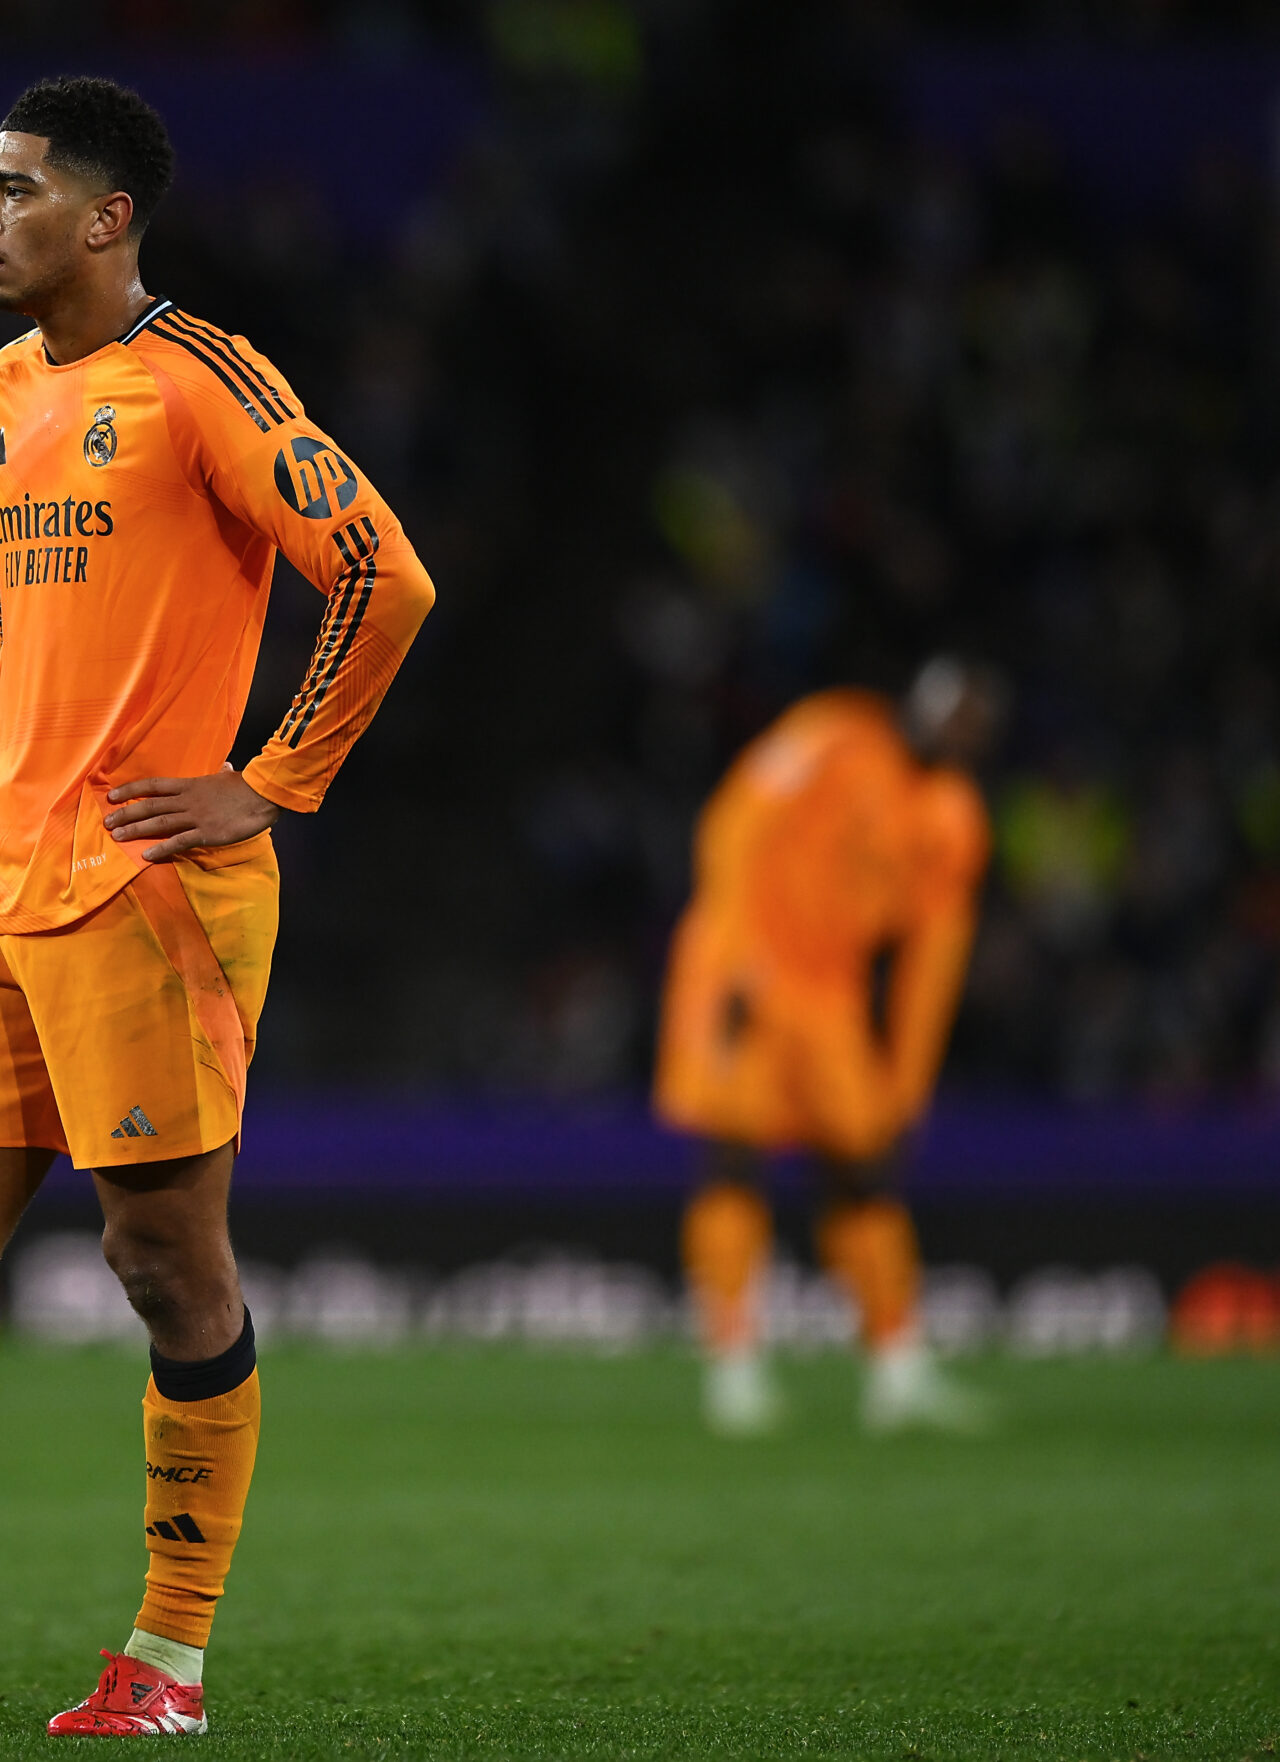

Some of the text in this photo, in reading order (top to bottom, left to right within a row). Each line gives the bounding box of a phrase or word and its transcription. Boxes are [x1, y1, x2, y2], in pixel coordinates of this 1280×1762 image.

[274, 437, 358, 519] hp
[5, 546, 88, 588] FLY BETTER
